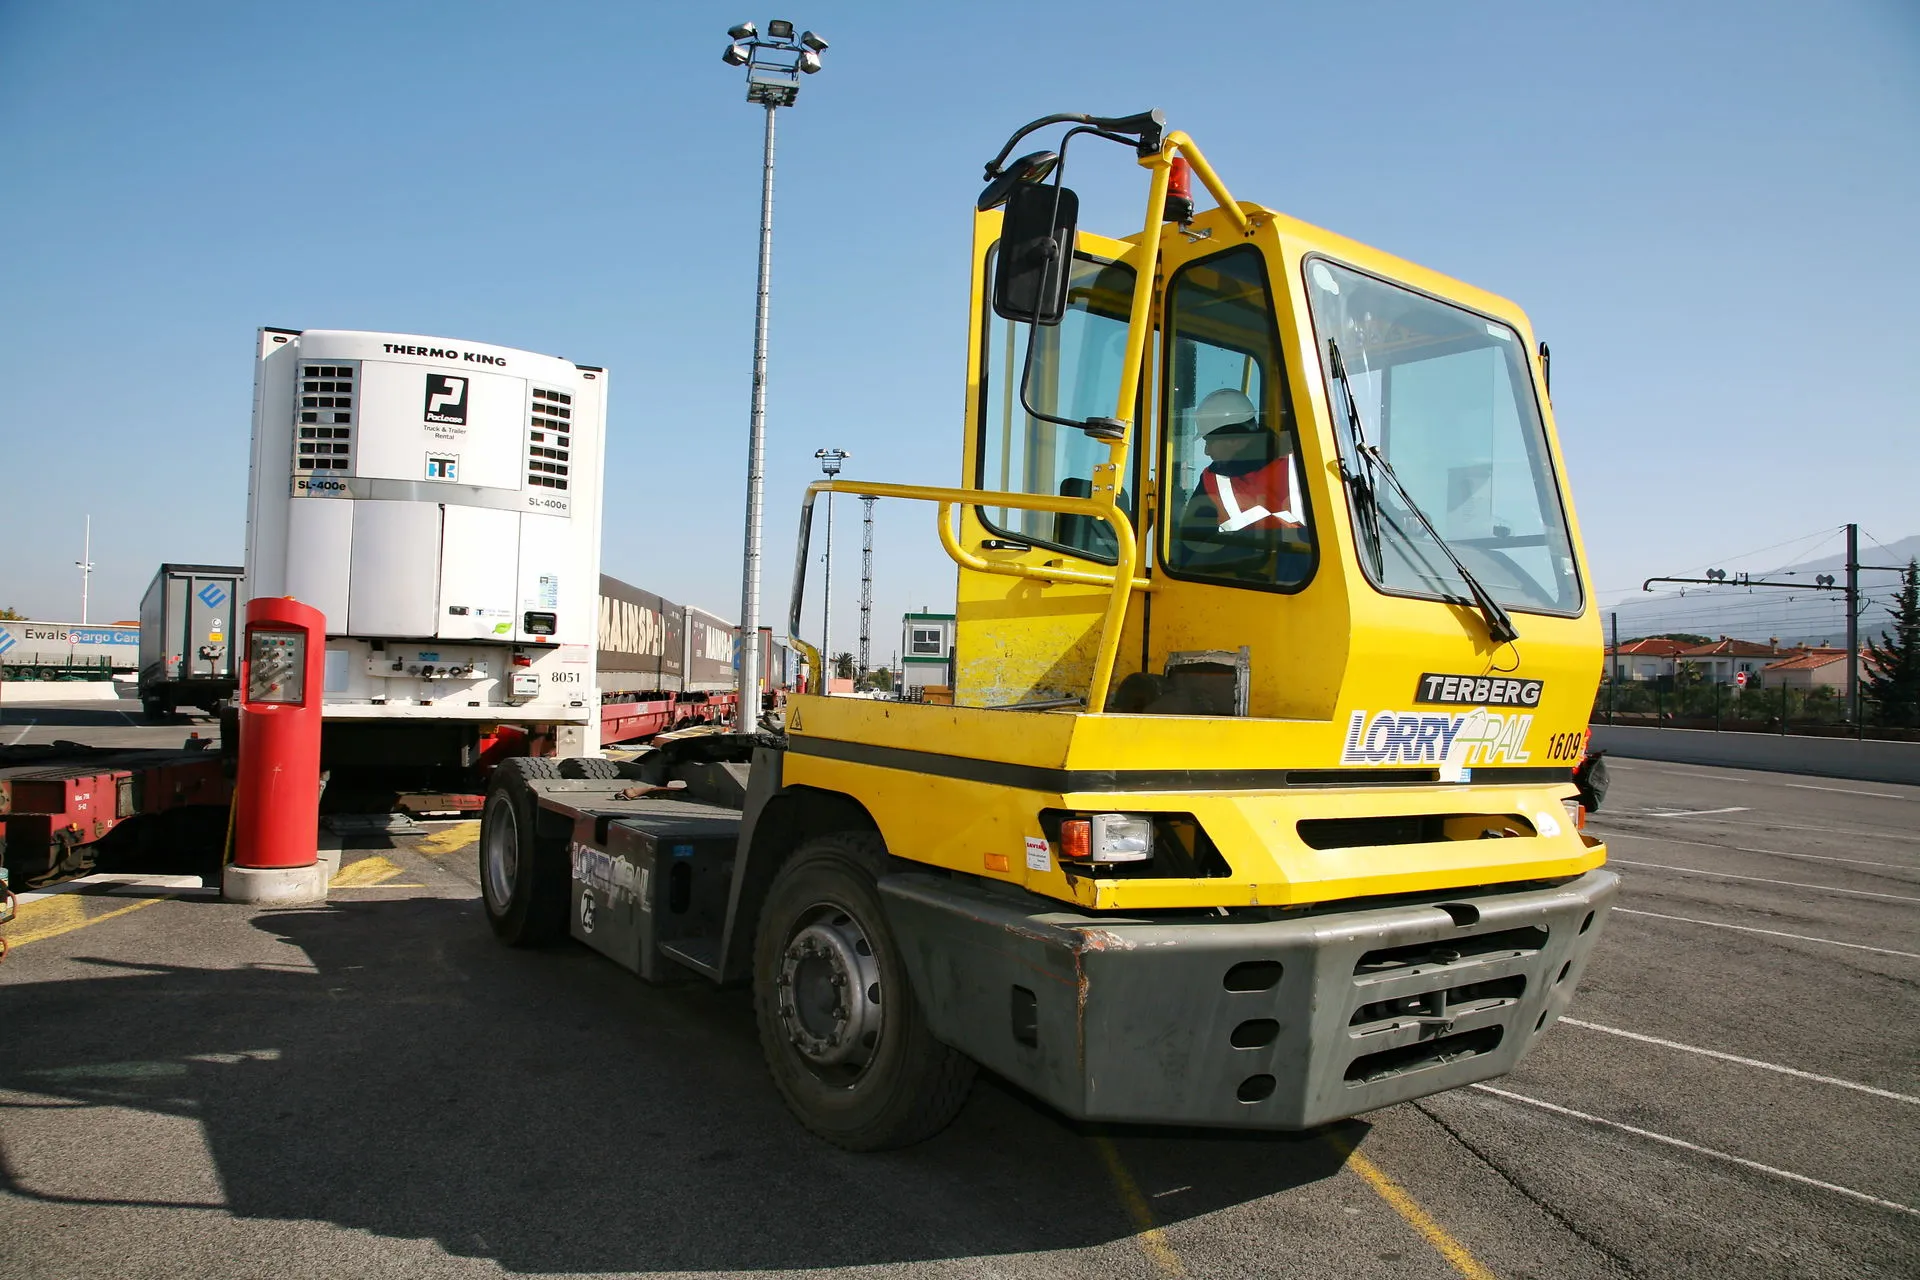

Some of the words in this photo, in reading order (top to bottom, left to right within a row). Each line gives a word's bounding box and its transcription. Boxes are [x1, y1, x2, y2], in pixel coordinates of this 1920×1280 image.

[383, 343, 458, 359] THERMO
[463, 352, 507, 367] KING
[298, 480, 346, 491] SL-400e
[528, 497, 567, 510] SL-400e
[25, 629, 68, 641] Ewals
[551, 672, 580, 683] 8051
[1425, 675, 1540, 705] TERBERG
[1340, 710, 1464, 766] LORRY
[1546, 732, 1582, 761] 1609
